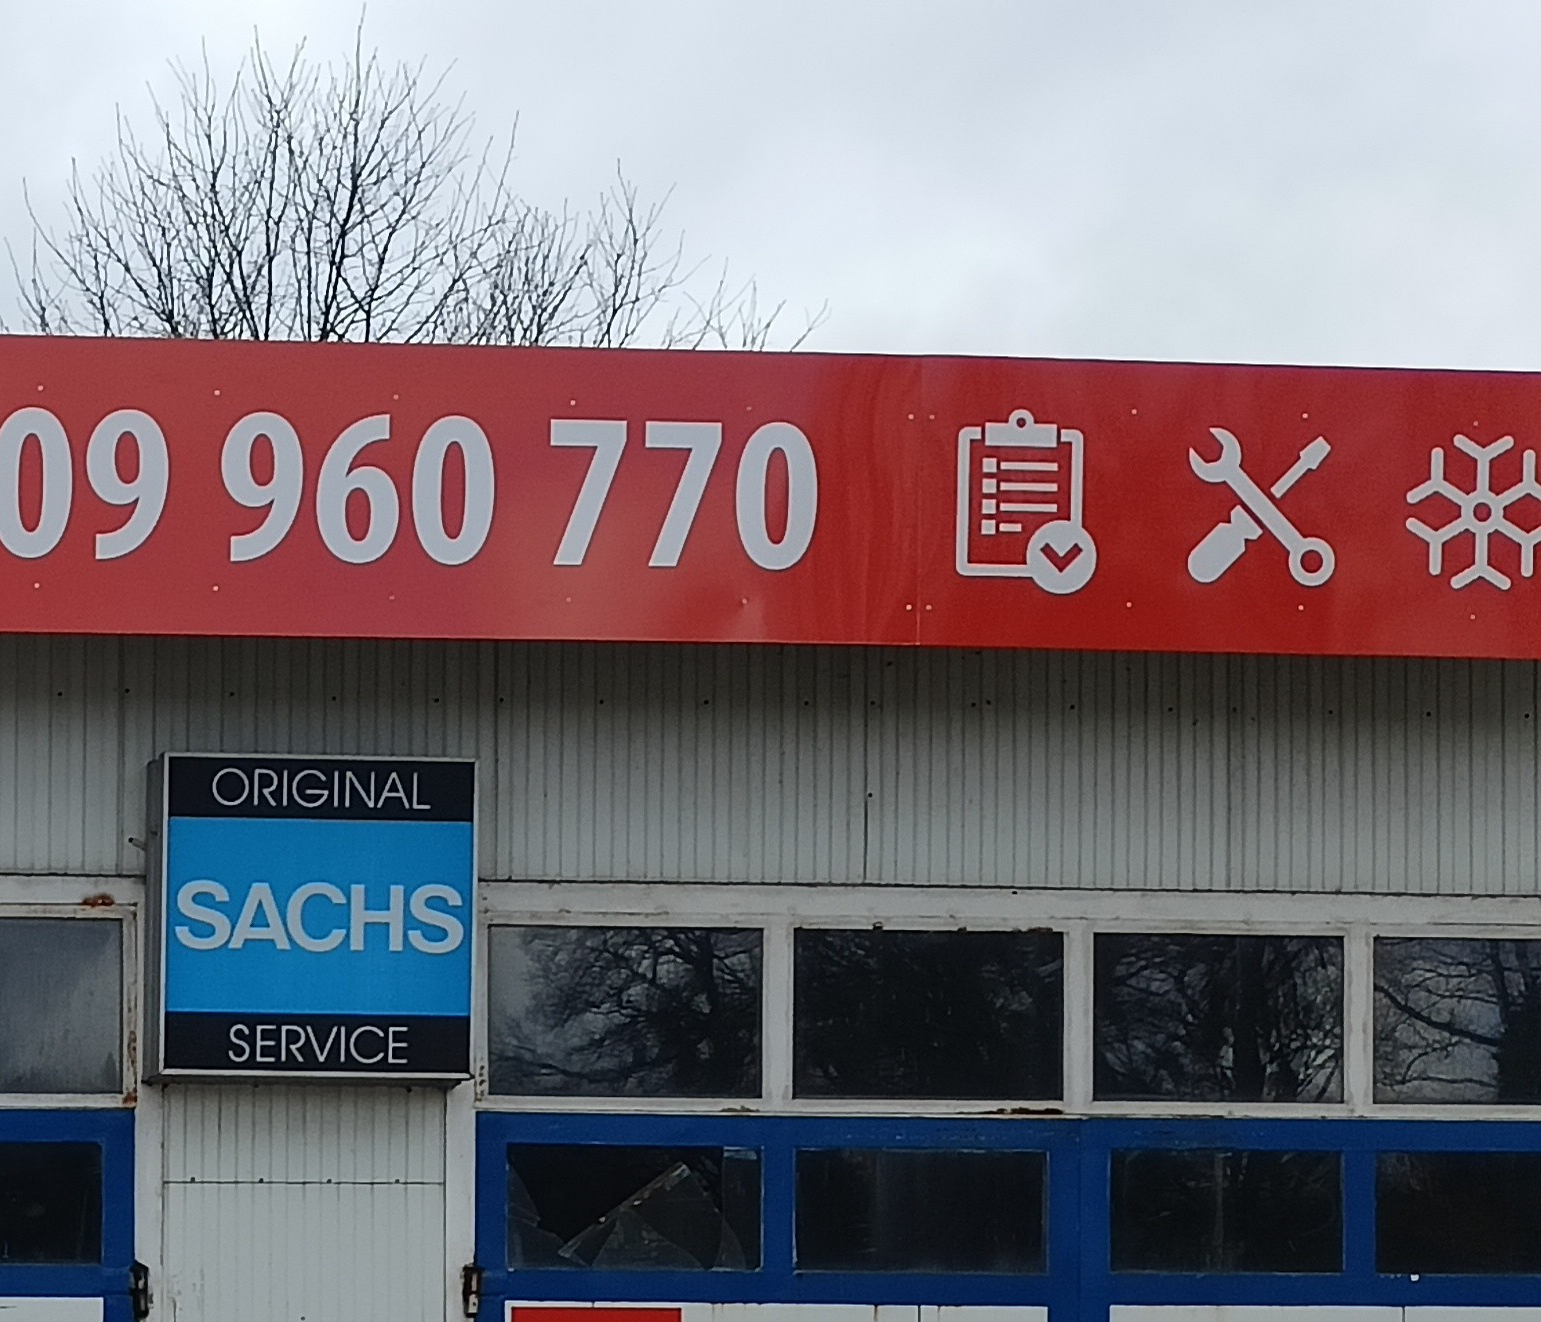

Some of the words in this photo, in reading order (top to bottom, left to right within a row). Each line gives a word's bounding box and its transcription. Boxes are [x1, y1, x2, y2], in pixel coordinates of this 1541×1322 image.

[219, 410, 496, 567] 960
[549, 418, 818, 571] 770
[211, 766, 432, 810] ORIGINAL
[174, 878, 465, 955] SACHS
[227, 1022, 409, 1064] SERVICE
